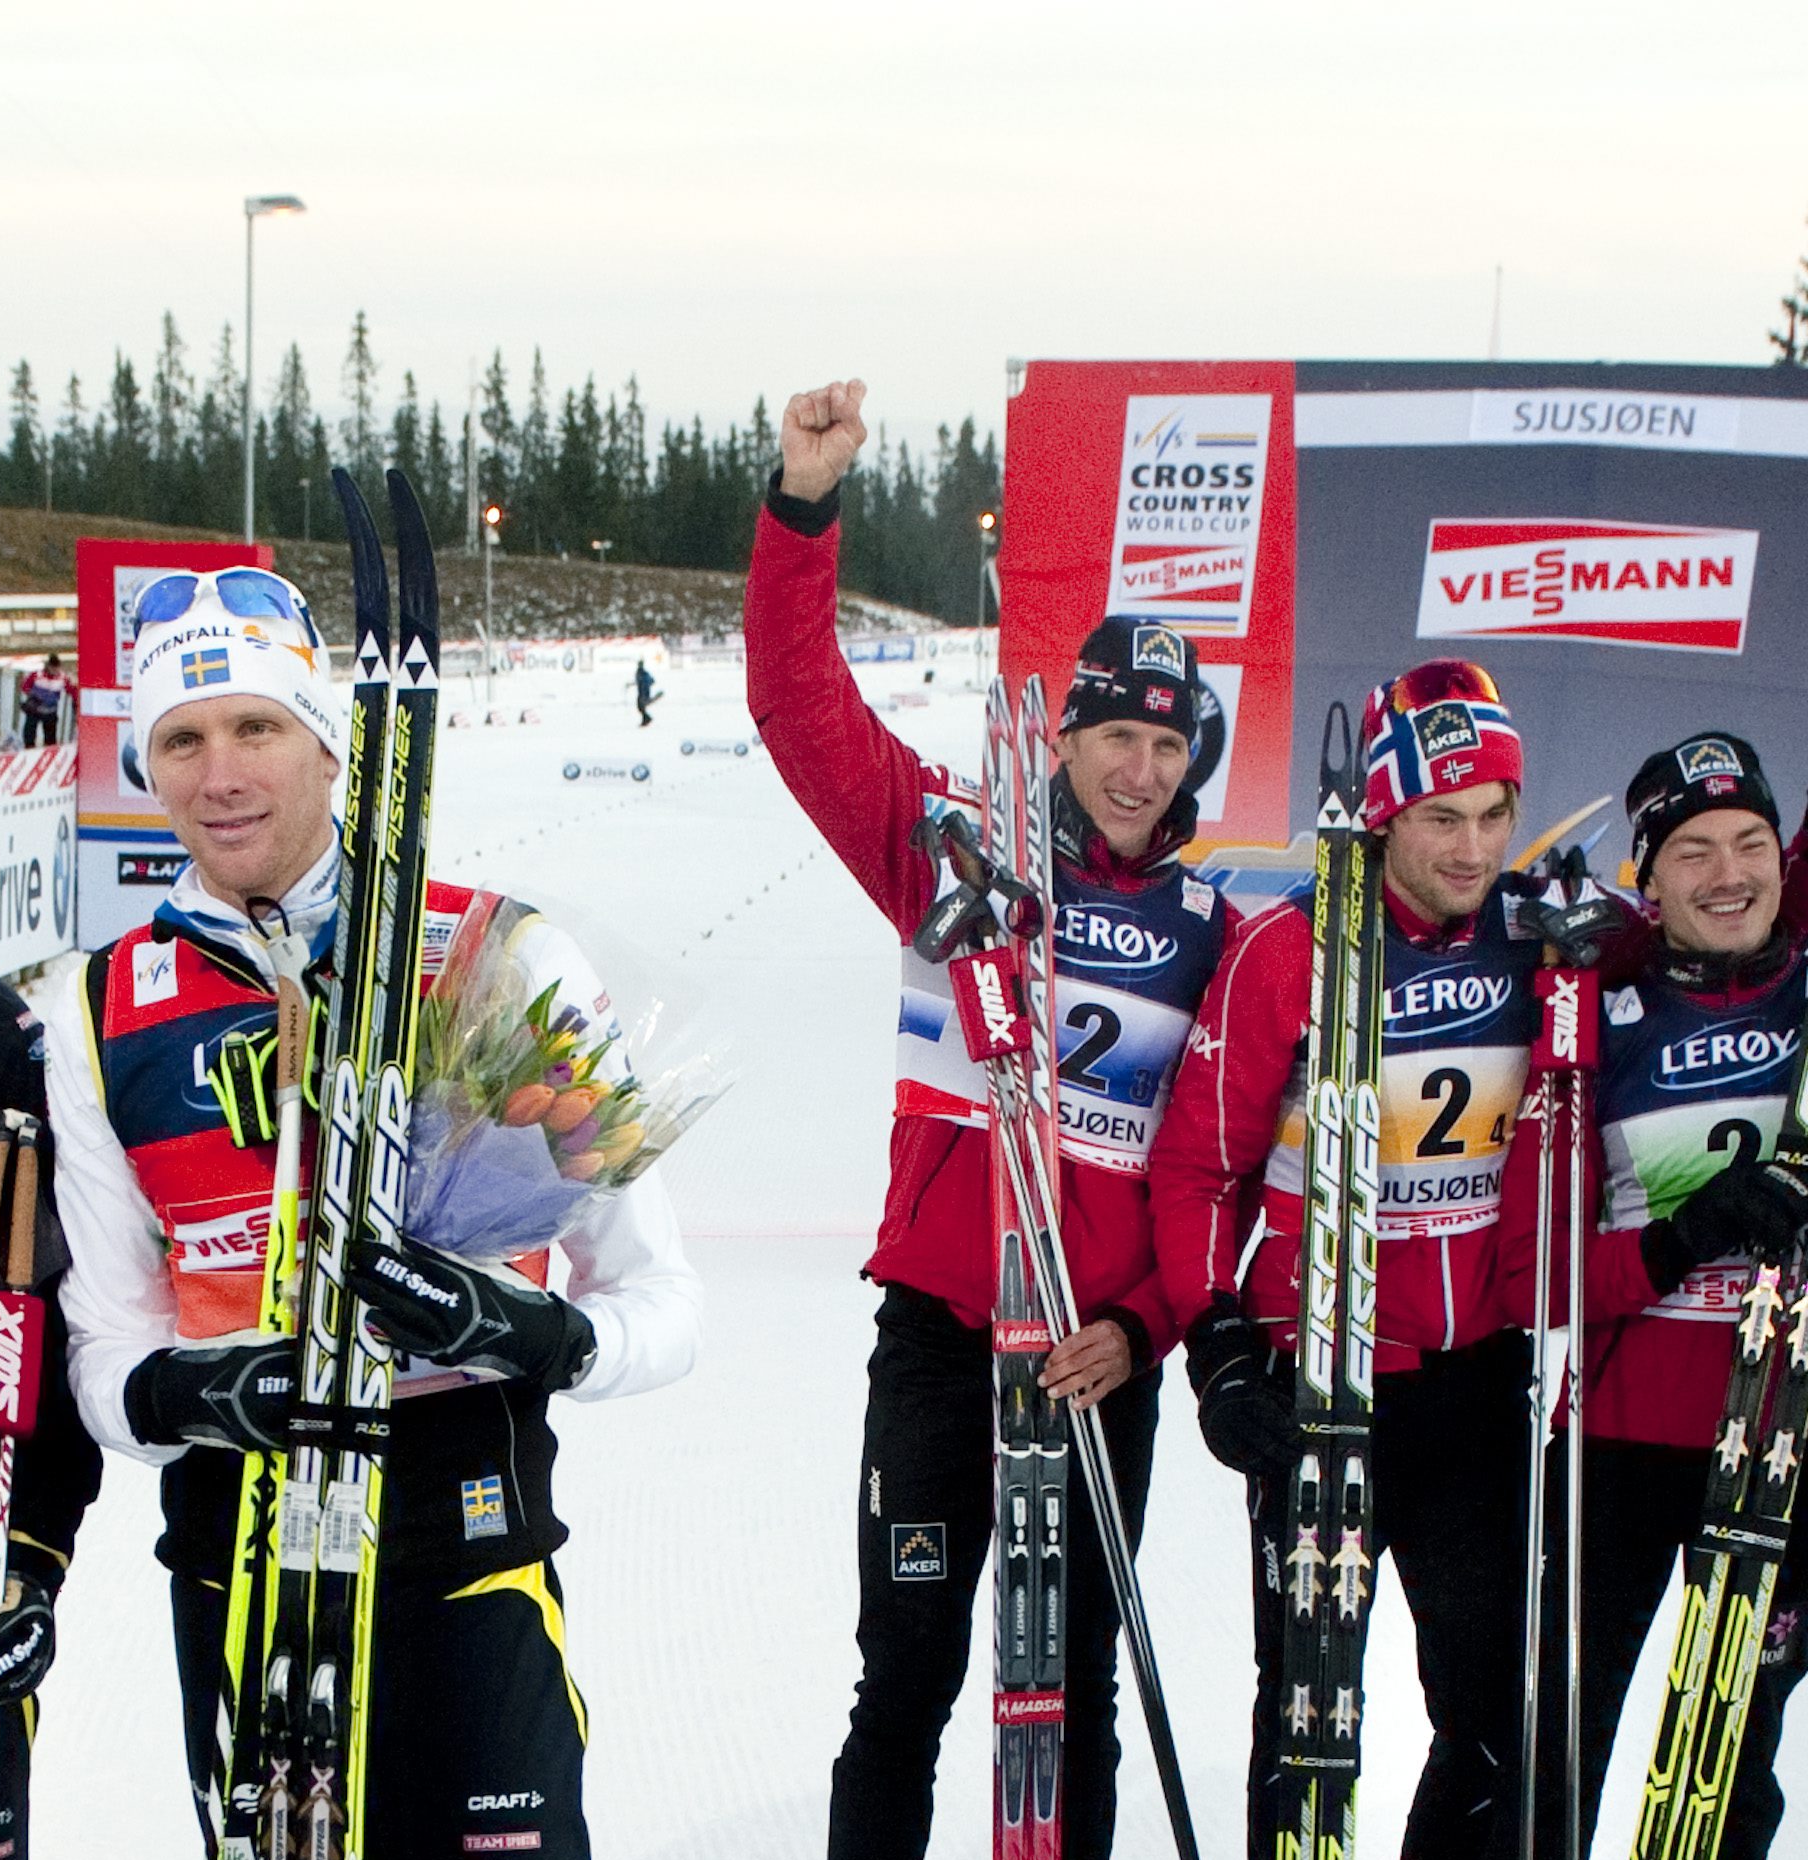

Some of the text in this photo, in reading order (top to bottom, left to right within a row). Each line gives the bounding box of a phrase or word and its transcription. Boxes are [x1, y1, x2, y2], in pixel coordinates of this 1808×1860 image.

[1513, 402, 1696, 438] SJUSJØEN
[1130, 464, 1255, 490] CROSS
[1127, 495, 1253, 515] COUNTRY
[1126, 516, 1252, 533] WORLD CUP
[1426, 729, 1473, 753] AKER
[343, 699, 368, 858] FISCHER
[384, 703, 414, 865] FISCHER
[585, 767, 627, 780] xDrive
[1313, 837, 1331, 944] FISCHER
[1348, 840, 1366, 949] FISCHER
[1053, 904, 1173, 963] LERØY
[1382, 975, 1506, 1020] LERØY
[1058, 1002, 1123, 1094] 2
[1660, 1027, 1798, 1077] LERØY
[1057, 1102, 1146, 1145] SJØEN
[1416, 1067, 1506, 1159] 2 4
[1378, 1168, 1502, 1206] JUSJØEN
[1006, 1326, 1052, 1346] MADS
[897, 1558, 943, 1575] AKER
[468, 1792, 529, 1811] CRAFT
[465, 1835, 503, 1850] TEAM
